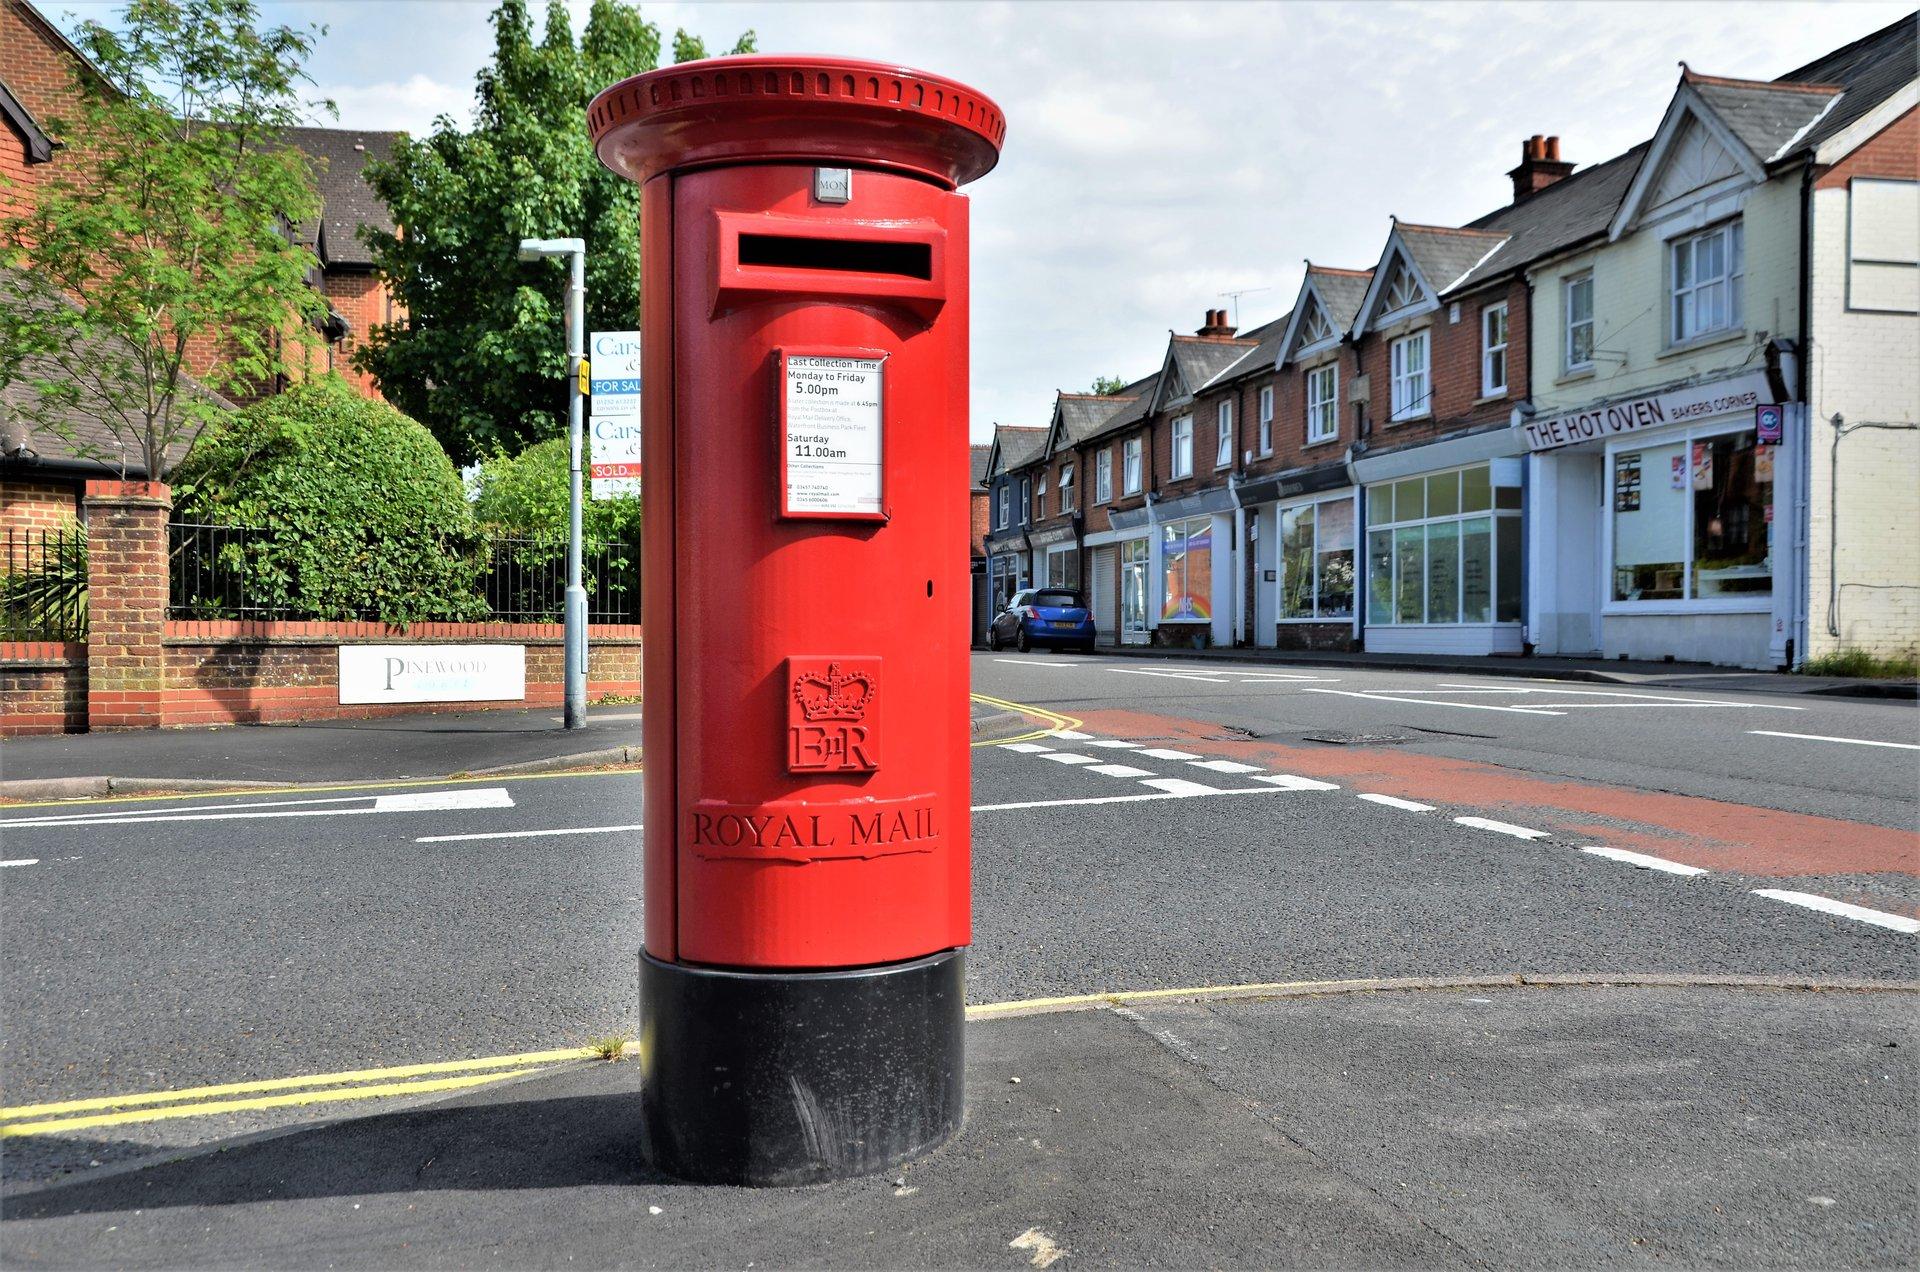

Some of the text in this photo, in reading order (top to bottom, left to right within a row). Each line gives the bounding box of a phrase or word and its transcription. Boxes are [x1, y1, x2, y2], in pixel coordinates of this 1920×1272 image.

[820, 180, 848, 190] MON
[788, 357, 876, 369] Last Collection Time
[788, 371, 823, 381] Monday
[837, 373, 866, 383] Friday
[595, 381, 619, 391] FOR
[796, 381, 838, 397] 5.00pm
[1671, 392, 1757, 419] BAKERS CORNER
[1526, 399, 1665, 447] THE HOT OVEN
[787, 433, 830, 444] Saturday
[795, 444, 847, 458] 11.00am
[595, 465, 628, 477] SOLD
[383, 657, 487, 691] PINEWOOD
[692, 807, 940, 848] ROYAL MAIL
